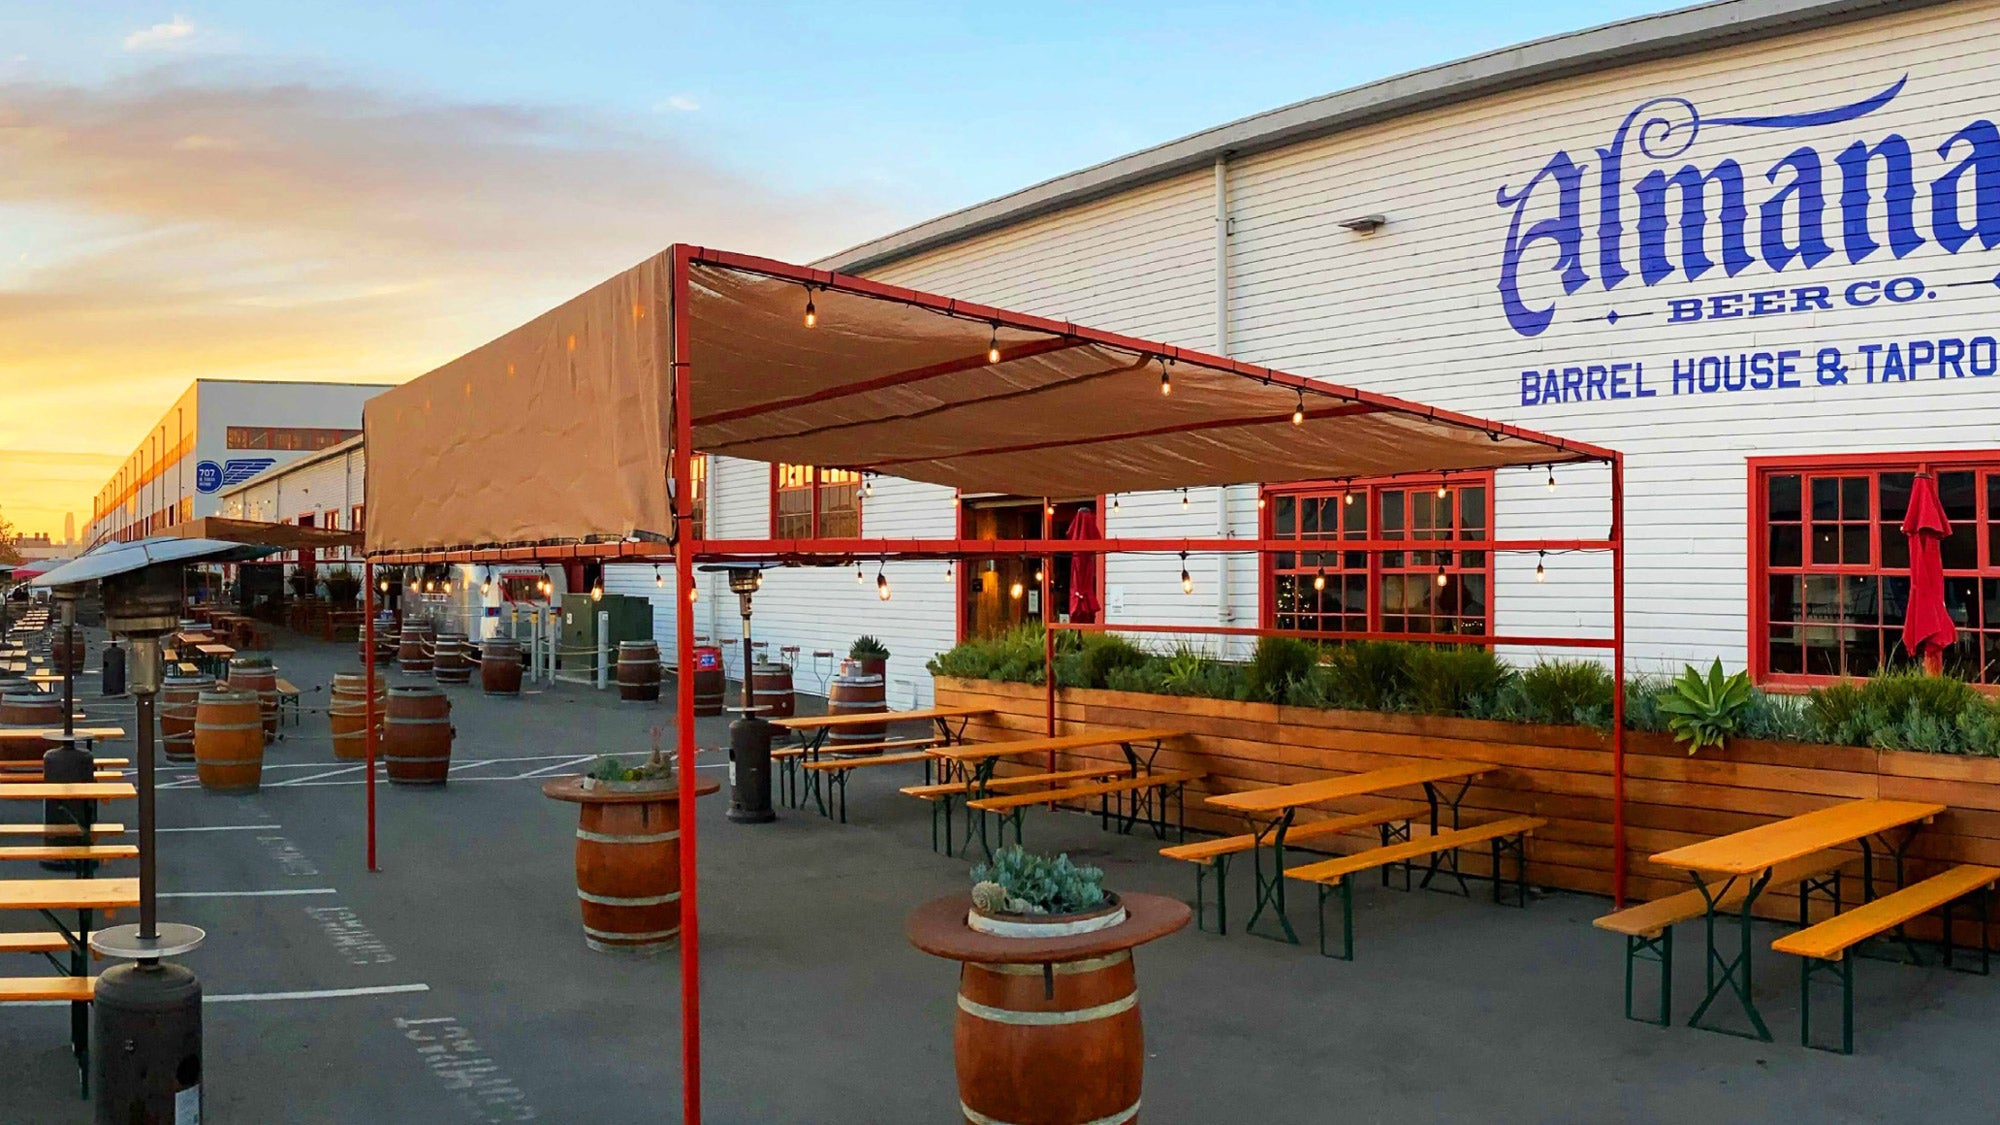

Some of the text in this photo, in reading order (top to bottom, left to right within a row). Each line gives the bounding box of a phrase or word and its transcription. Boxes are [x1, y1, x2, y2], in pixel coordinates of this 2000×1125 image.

[1666, 277, 1938, 324] BEER CO.
[1521, 336, 1998, 406] BARREL HOUSE & TAPRO
[199, 469, 215, 477] 707
